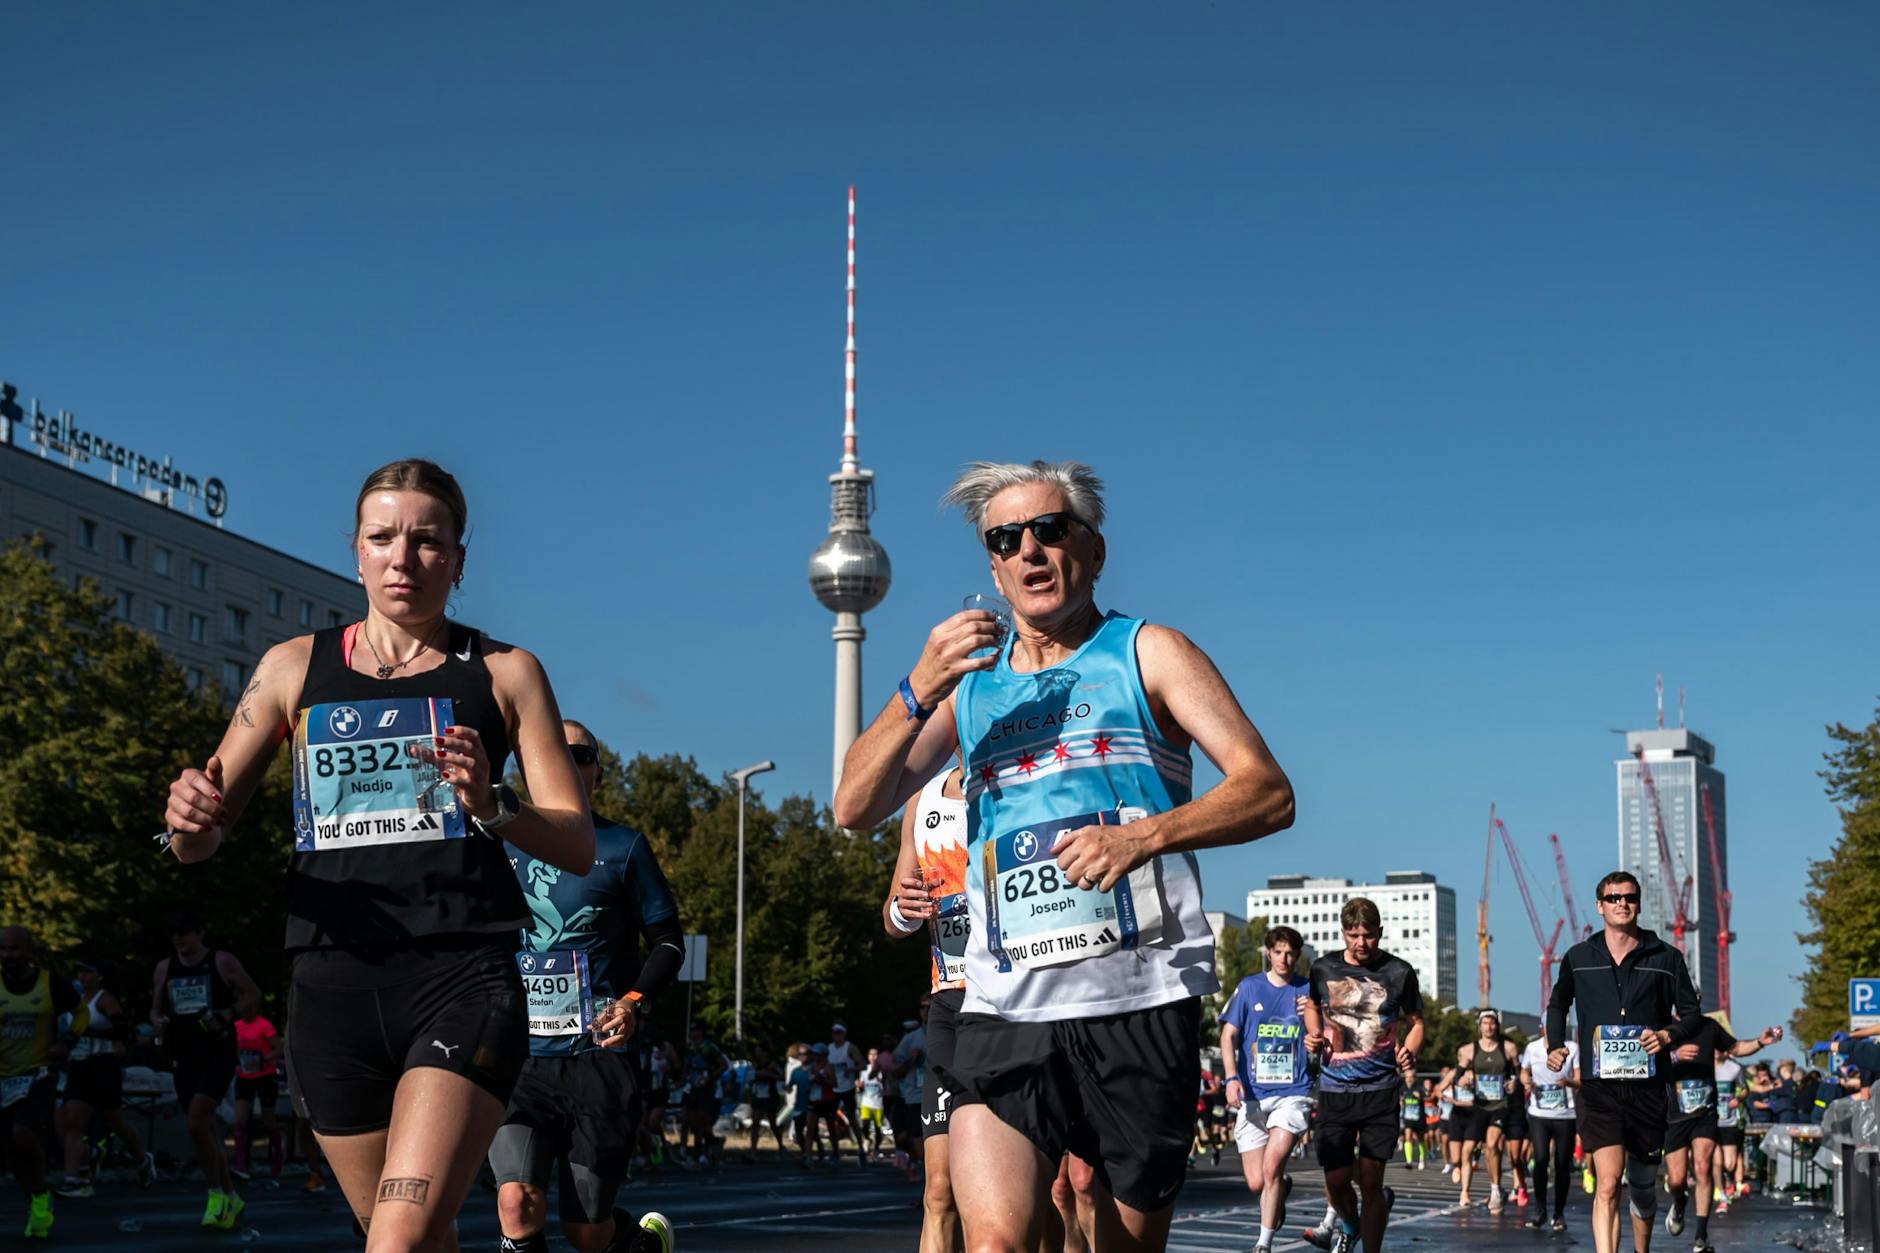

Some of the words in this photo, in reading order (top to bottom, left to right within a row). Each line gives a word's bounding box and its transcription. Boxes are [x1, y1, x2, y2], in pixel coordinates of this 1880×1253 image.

[989, 703, 1091, 741] CHICAGO
[351, 779, 393, 794] Nadja
[317, 823, 341, 839] YOU
[345, 819, 371, 837] GOT
[373, 817, 406, 834] THIS
[1030, 897, 1076, 917] Joseph
[1095, 907, 1103, 918] E
[1008, 945, 1027, 961] YOU
[1031, 939, 1054, 957] GOT
[1057, 933, 1088, 952] THIS
[947, 965, 958, 974] YOU
[523, 976, 569, 995] 1490
[529, 998, 554, 1006] Stefan
[1855, 983, 1873, 1011] P
[528, 1021, 541, 1030] GOT
[542, 1020, 560, 1030] THIS
[1258, 1023, 1300, 1039] BERLIN
[1604, 1041, 1642, 1053] 23207
[1261, 1055, 1288, 1064] 26241
